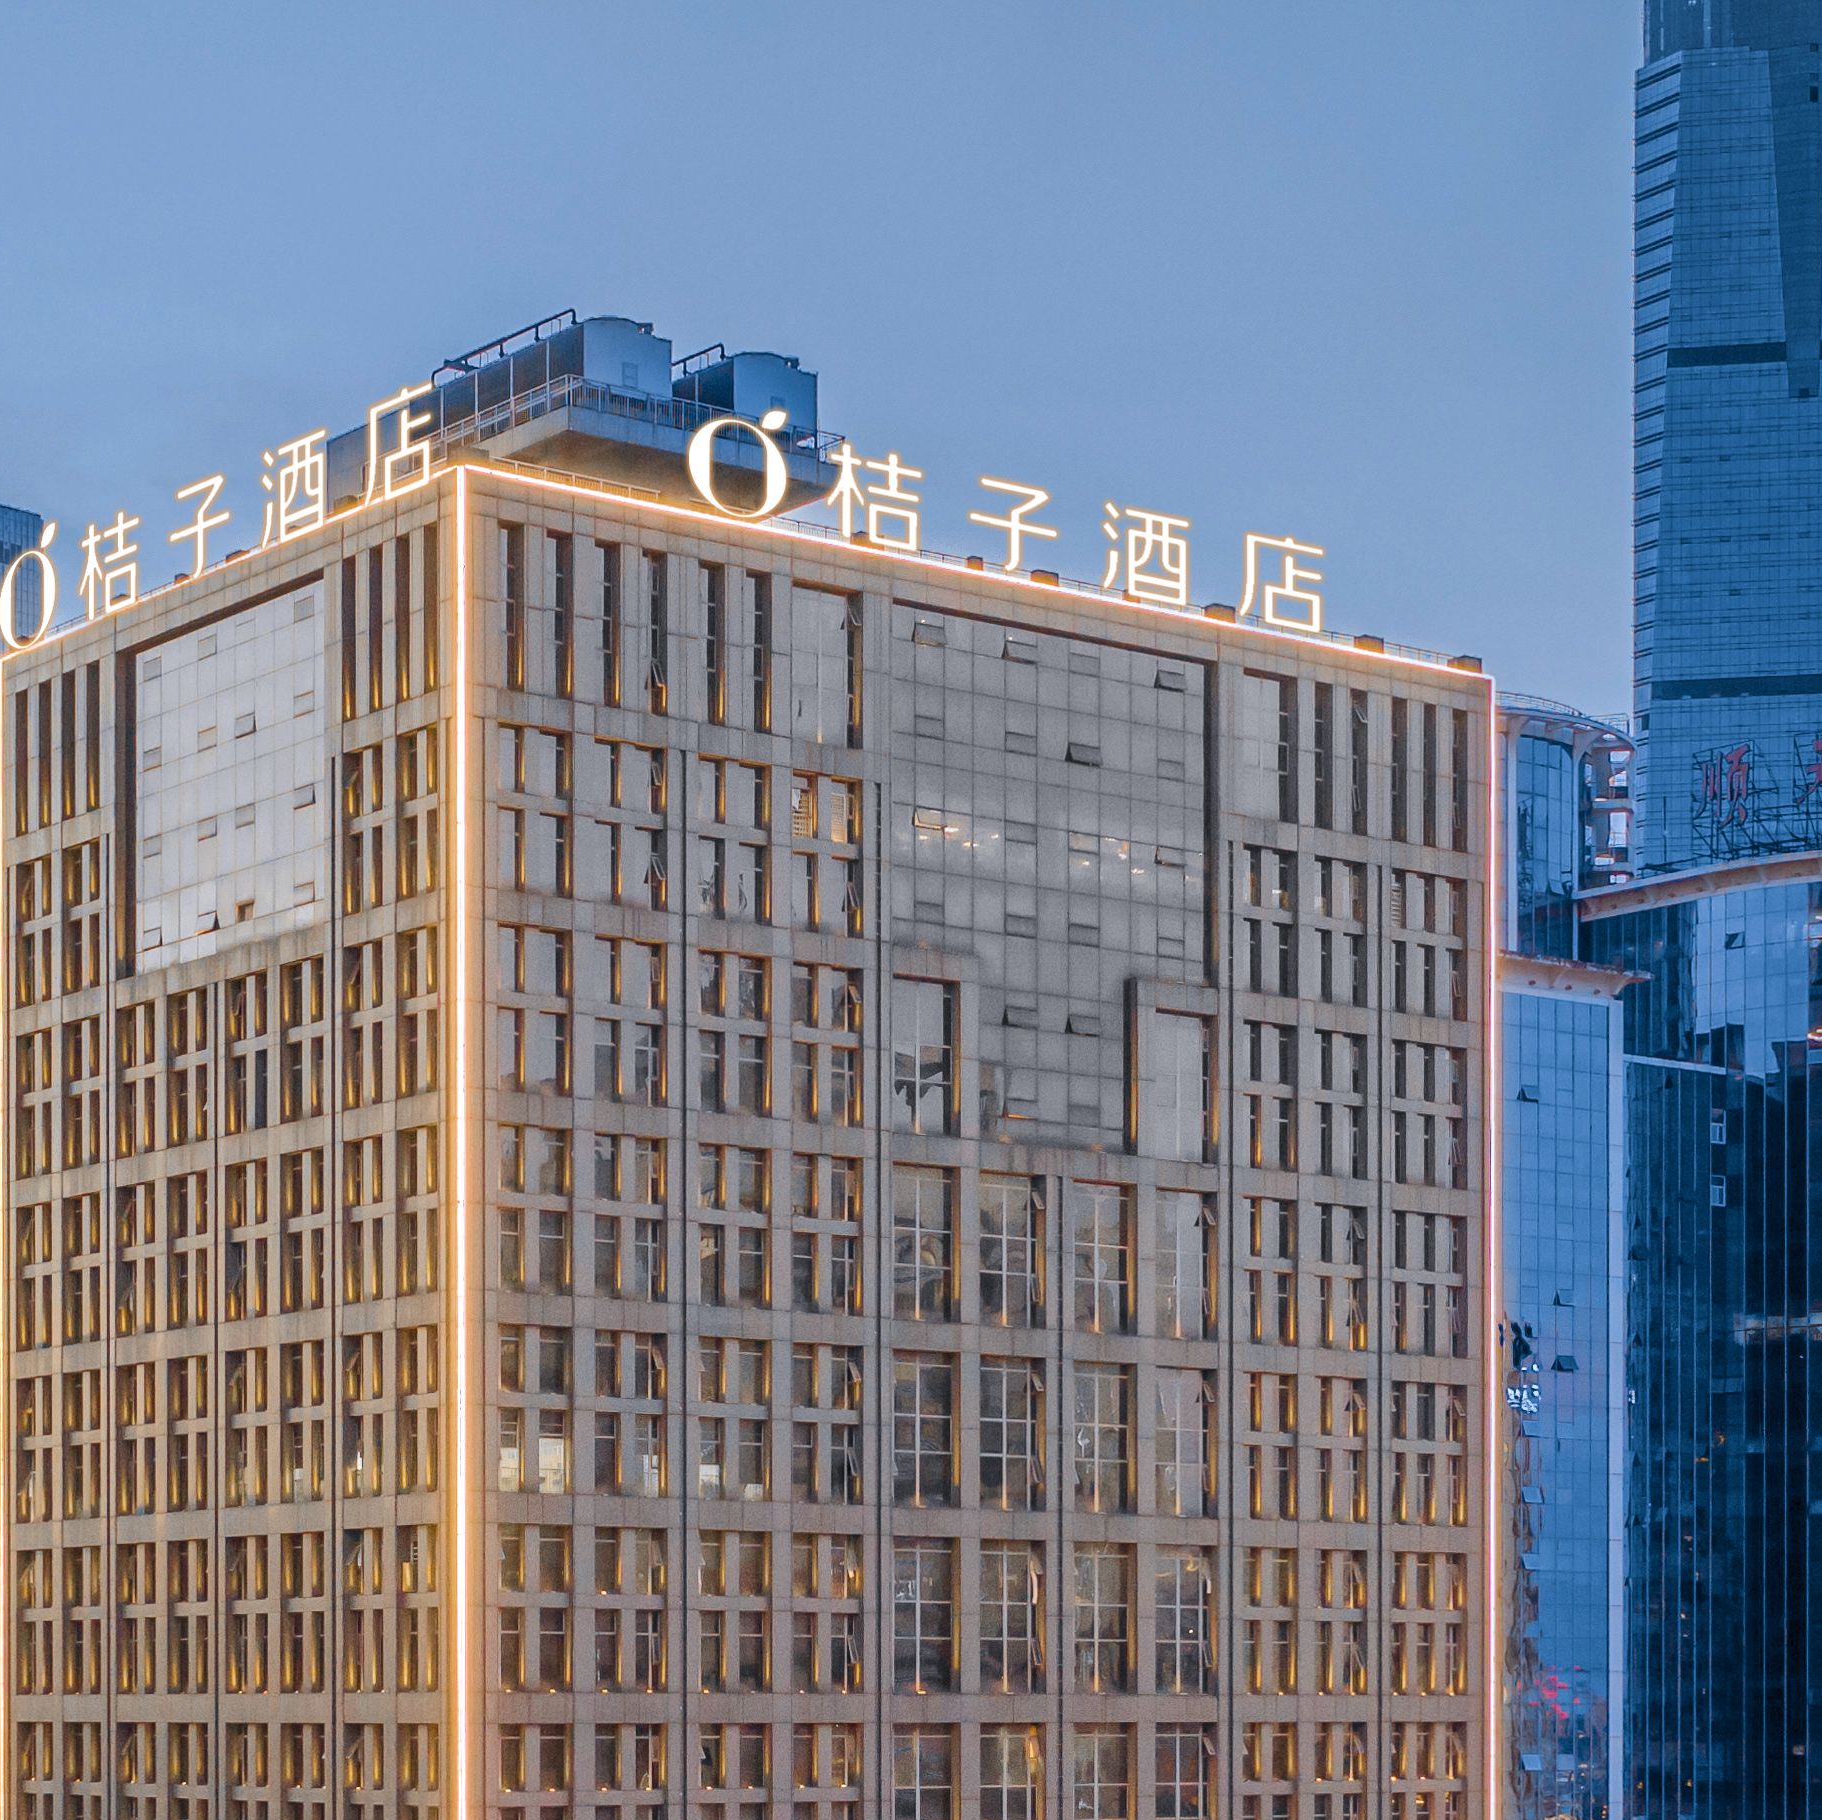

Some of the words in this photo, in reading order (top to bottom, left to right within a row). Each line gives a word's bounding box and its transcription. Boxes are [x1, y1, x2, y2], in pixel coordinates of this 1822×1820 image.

[79, 382, 435, 622] 桔子酒店
[826, 443, 1325, 634] 桔子酒店
